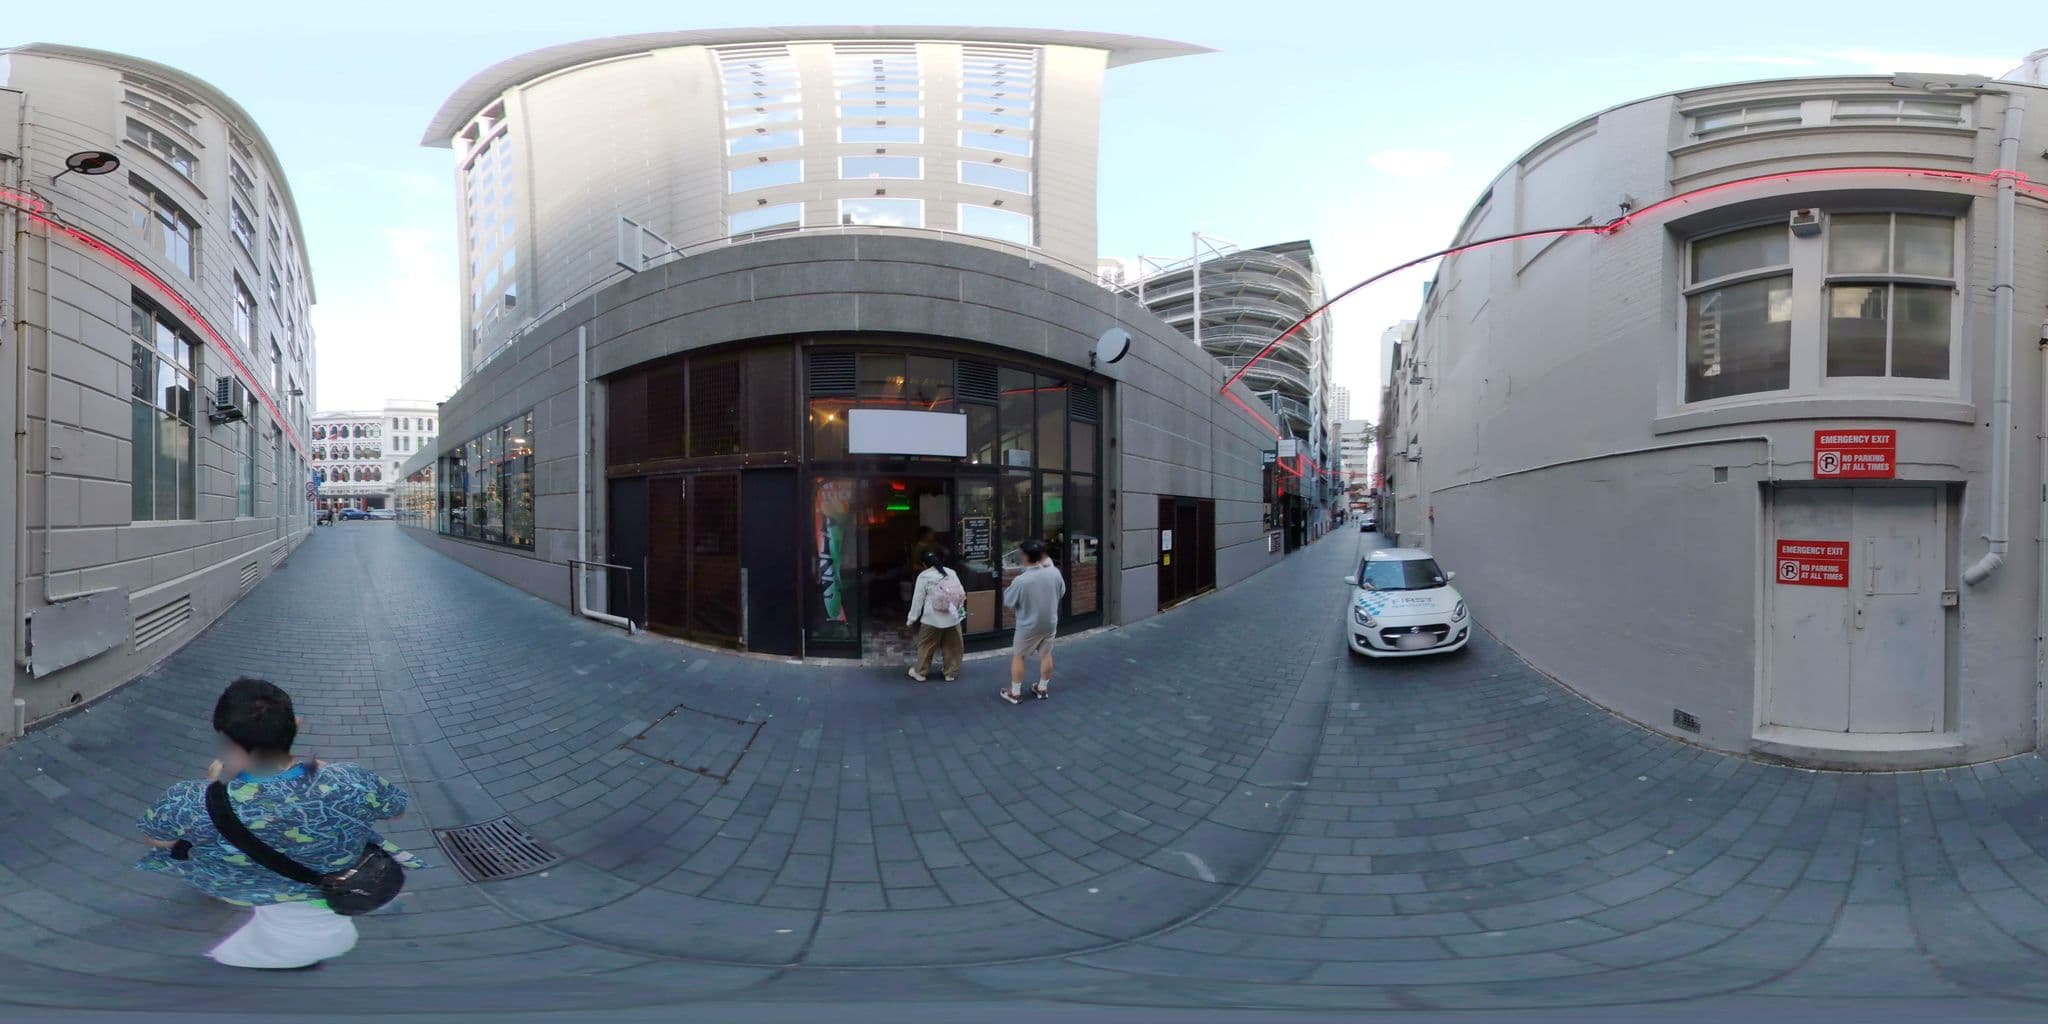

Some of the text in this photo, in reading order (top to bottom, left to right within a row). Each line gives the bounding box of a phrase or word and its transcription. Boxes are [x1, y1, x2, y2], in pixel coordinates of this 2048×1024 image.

[1820, 435, 1890, 444] EMERGENCY EXIT
[1841, 454, 1885, 462] NO PARKING
[1841, 463, 1890, 471] AT ALL TIMES
[1782, 546, 1844, 556] EMERGENCY EXIT
[1811, 565, 1840, 573] PARKING
[1810, 572, 1822, 580] ALL
[1823, 573, 1844, 581] TIMES
